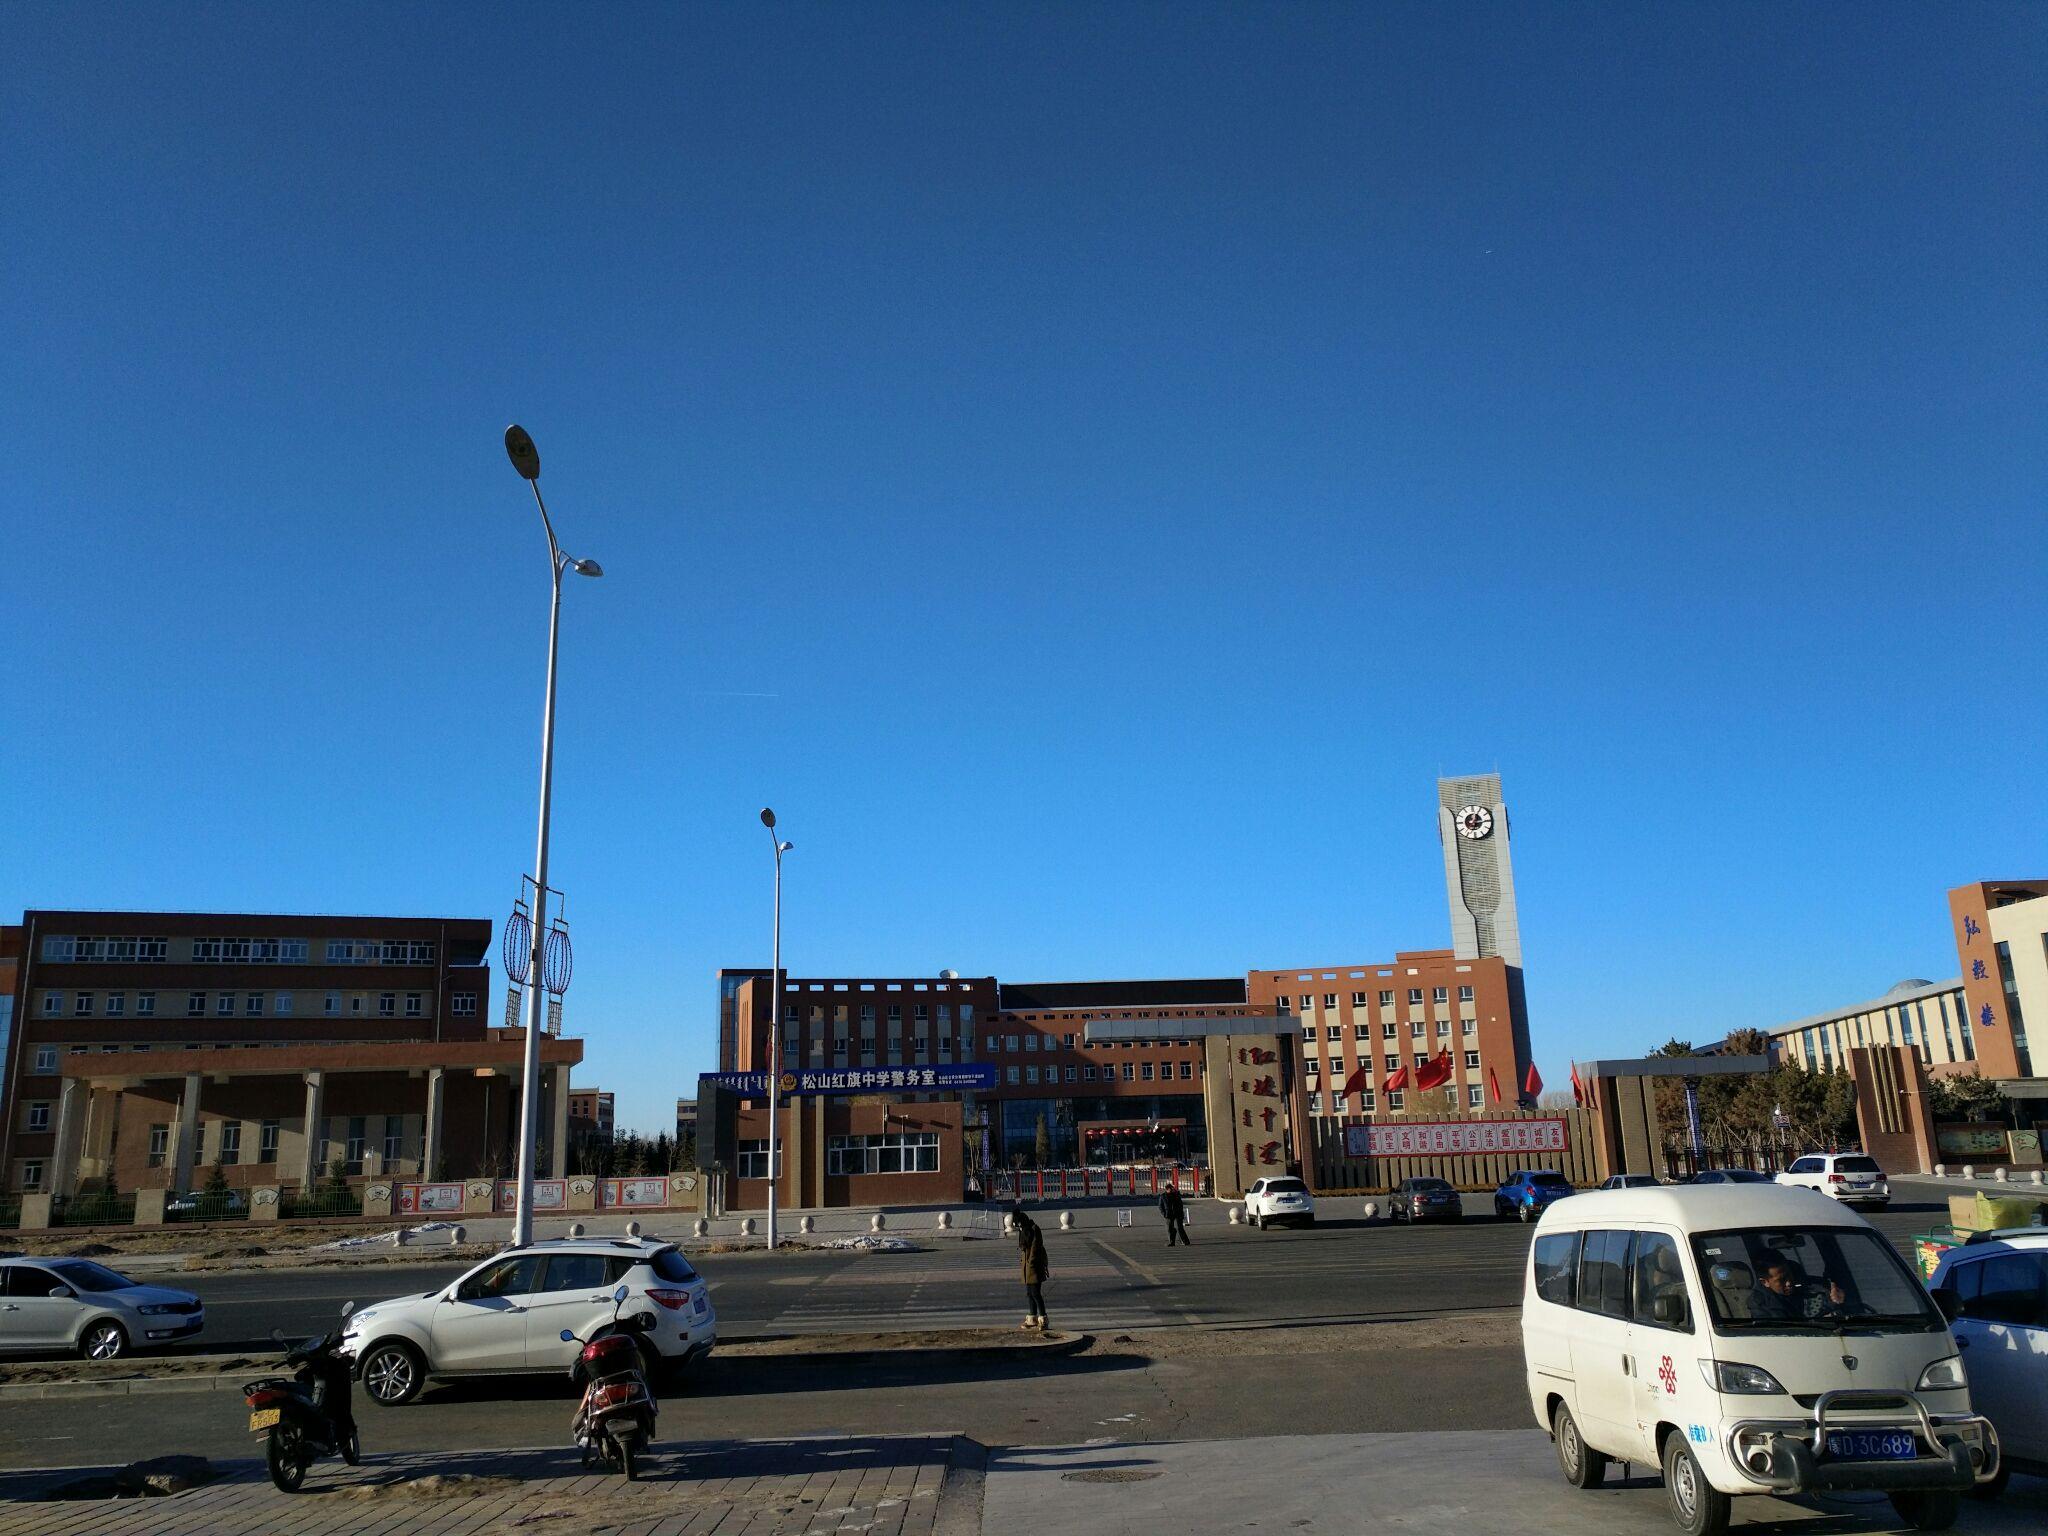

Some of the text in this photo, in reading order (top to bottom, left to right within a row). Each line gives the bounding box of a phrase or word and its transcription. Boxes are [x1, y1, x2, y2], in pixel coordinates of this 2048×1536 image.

[801, 1069, 936, 1090] 松山红旗中学警务室
